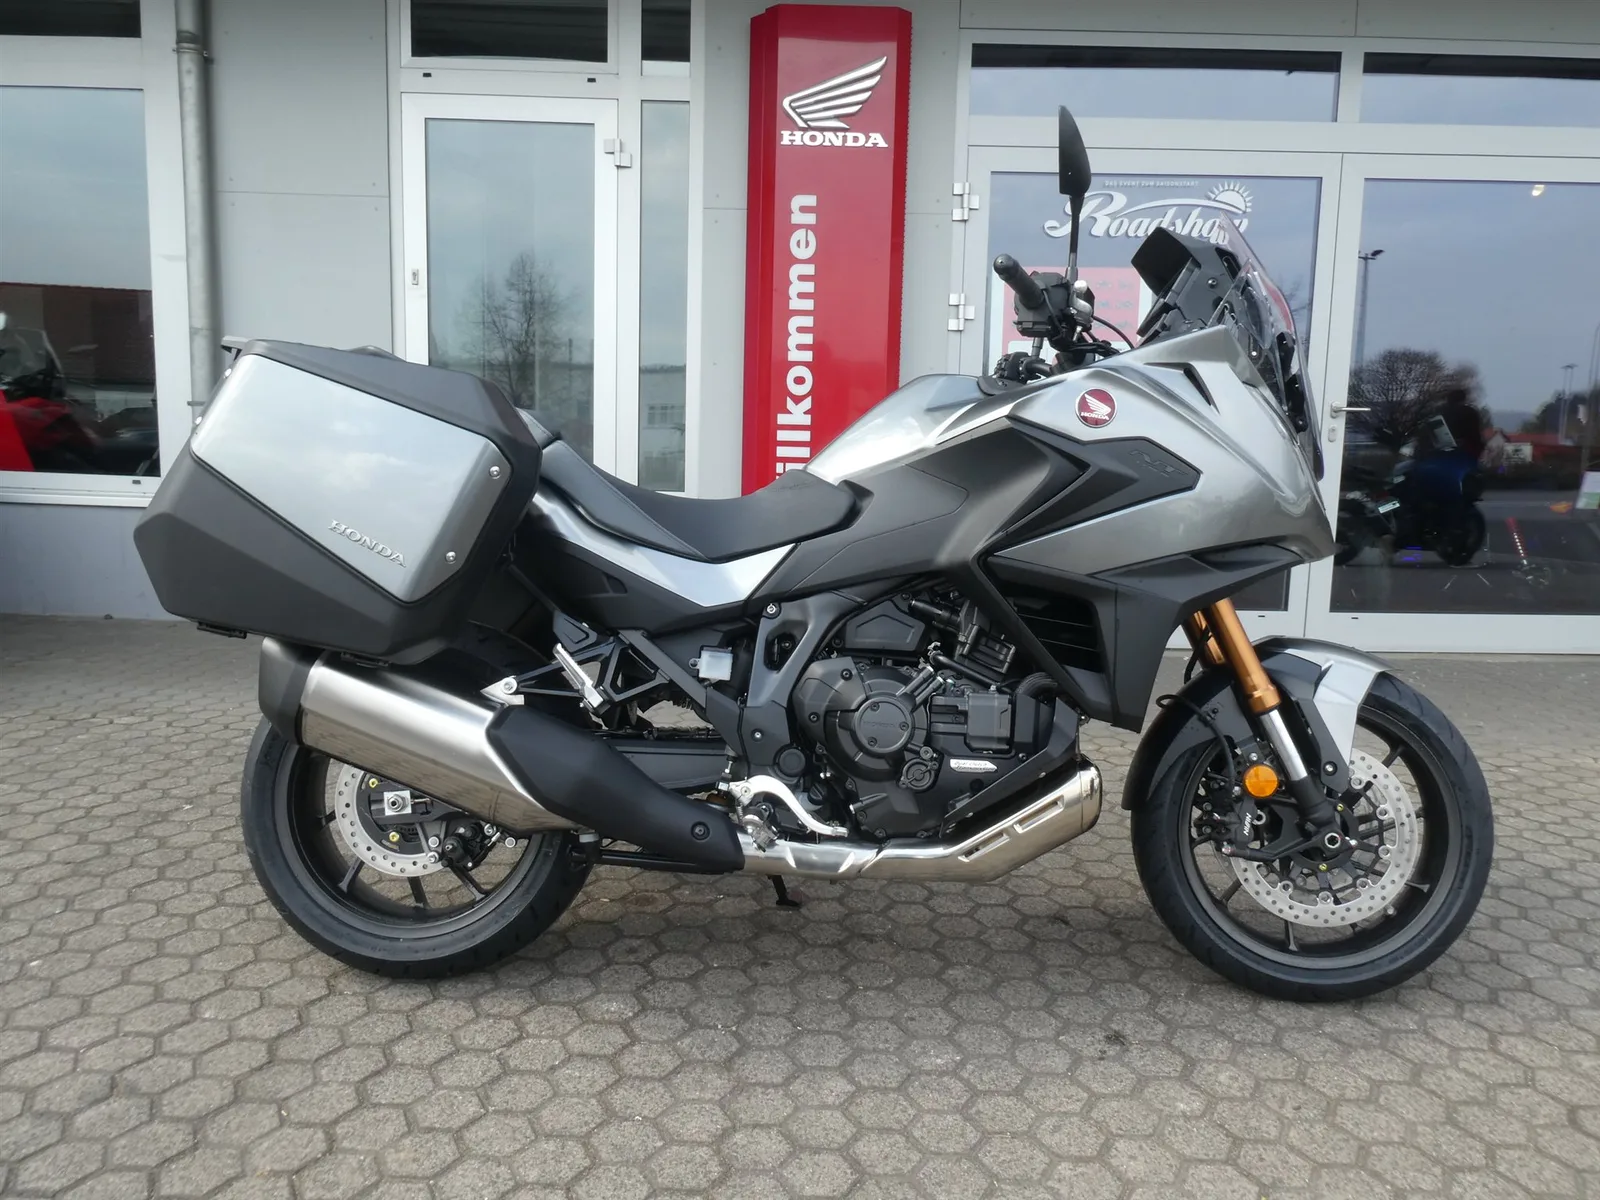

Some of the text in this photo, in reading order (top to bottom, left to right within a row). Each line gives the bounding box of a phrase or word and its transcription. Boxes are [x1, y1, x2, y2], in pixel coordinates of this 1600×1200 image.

[780, 130, 888, 148] HONDA
[775, 194, 817, 479] illkommen
[1080, 411, 1110, 421] HONDA
[327, 519, 407, 568] HONDA
